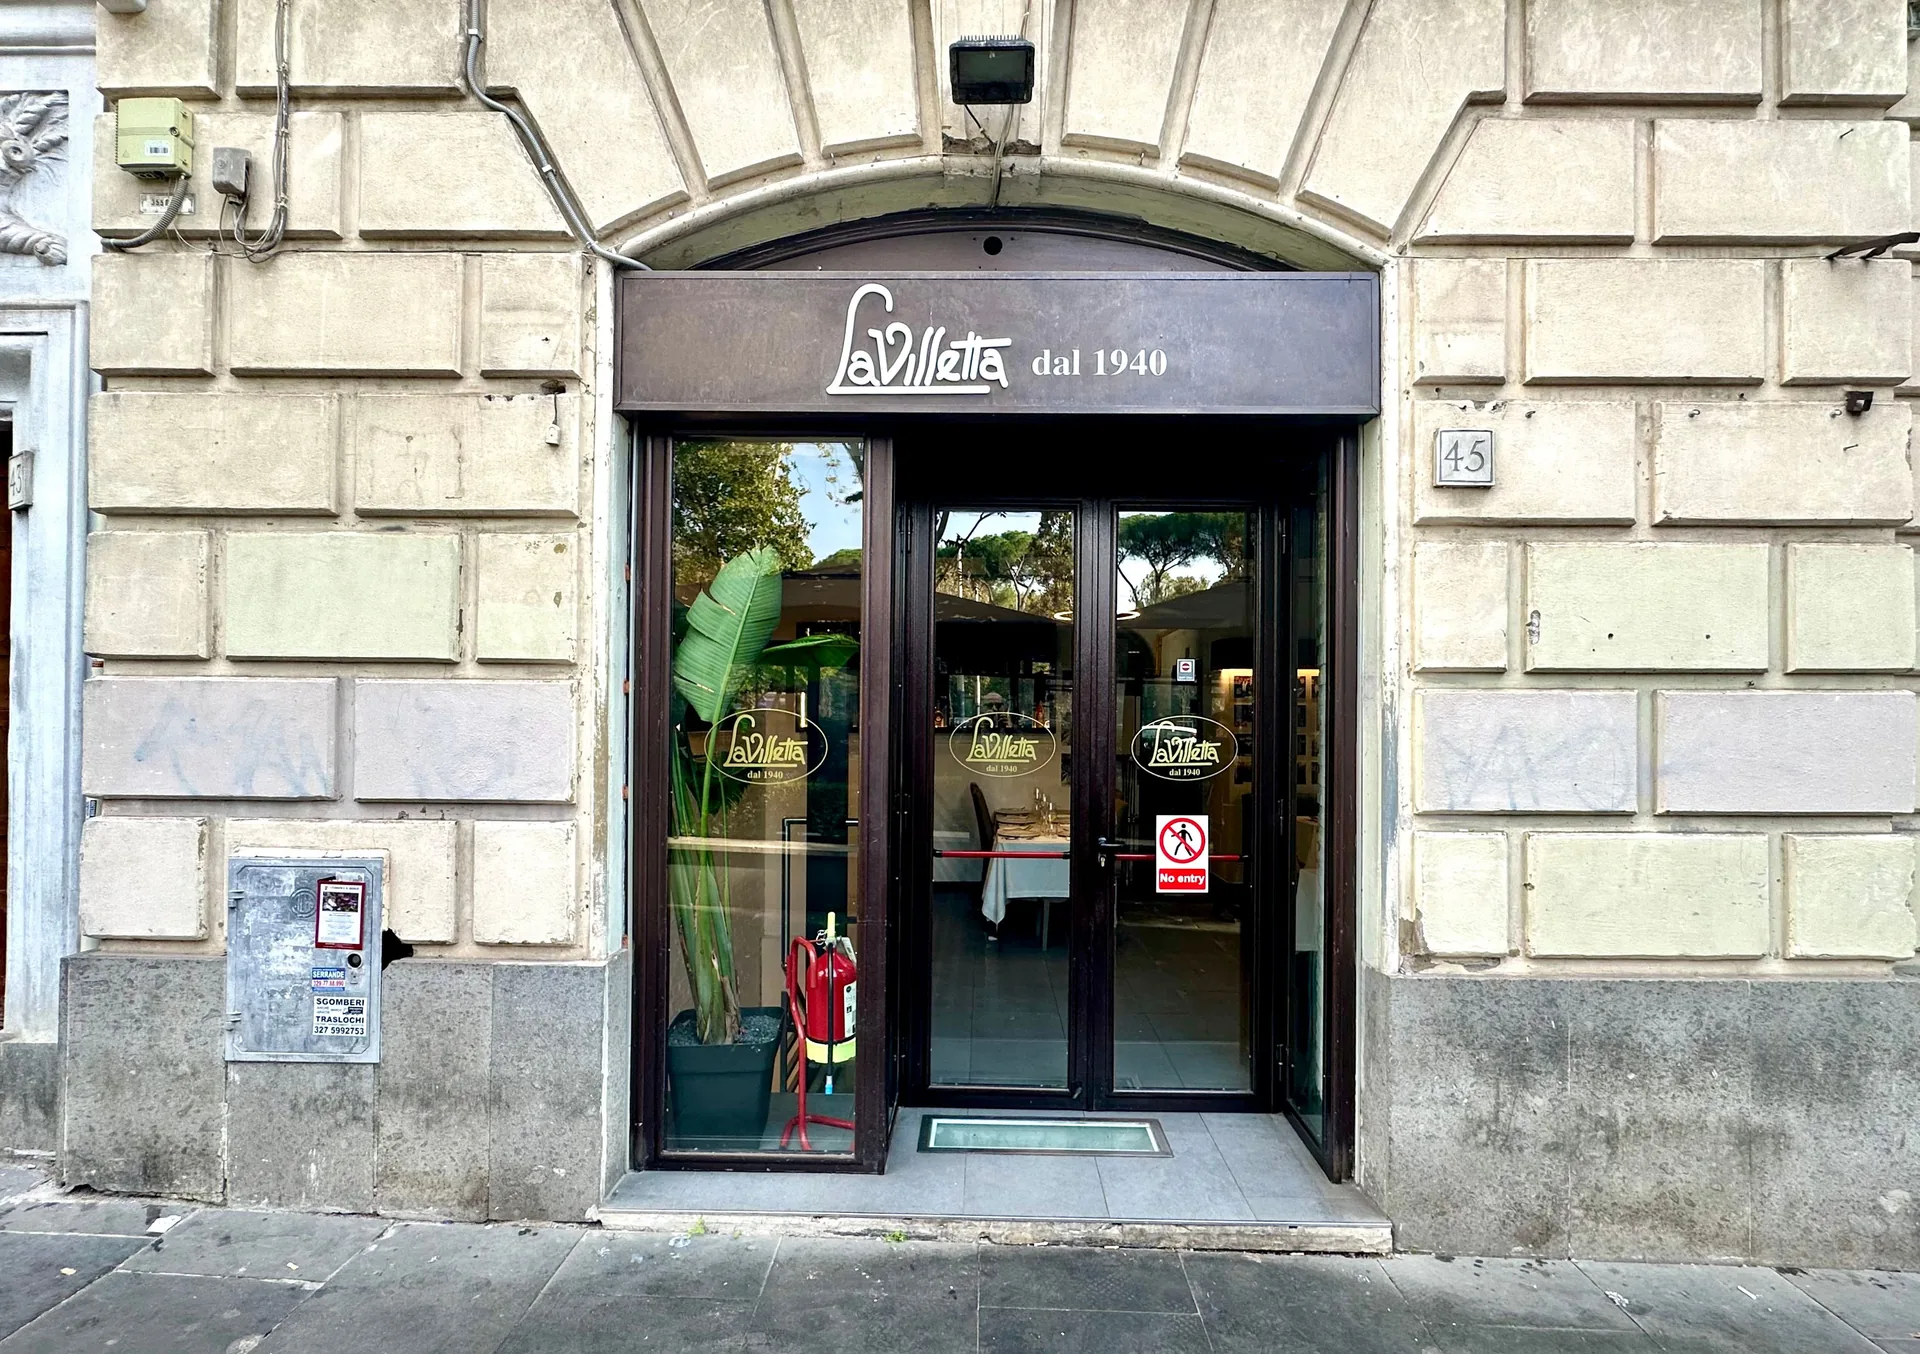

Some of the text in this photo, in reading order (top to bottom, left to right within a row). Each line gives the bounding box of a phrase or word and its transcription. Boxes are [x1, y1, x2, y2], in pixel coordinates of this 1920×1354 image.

[1031, 349, 1081, 376] dal
[1092, 349, 1168, 376] 1940
[1444, 439, 1485, 472] 45
[986, 764, 1018, 773] dal 1940
[1169, 768, 1201, 776] dal 1940
[747, 770, 784, 779] dal 1940
[1160, 873, 1205, 885] No entry
[312, 970, 345, 979] SERRANDE
[316, 998, 365, 1007] SGOMBERI
[315, 1015, 365, 1024] TRASLOCHI
[314, 1026, 365, 1035] 327 5992753
